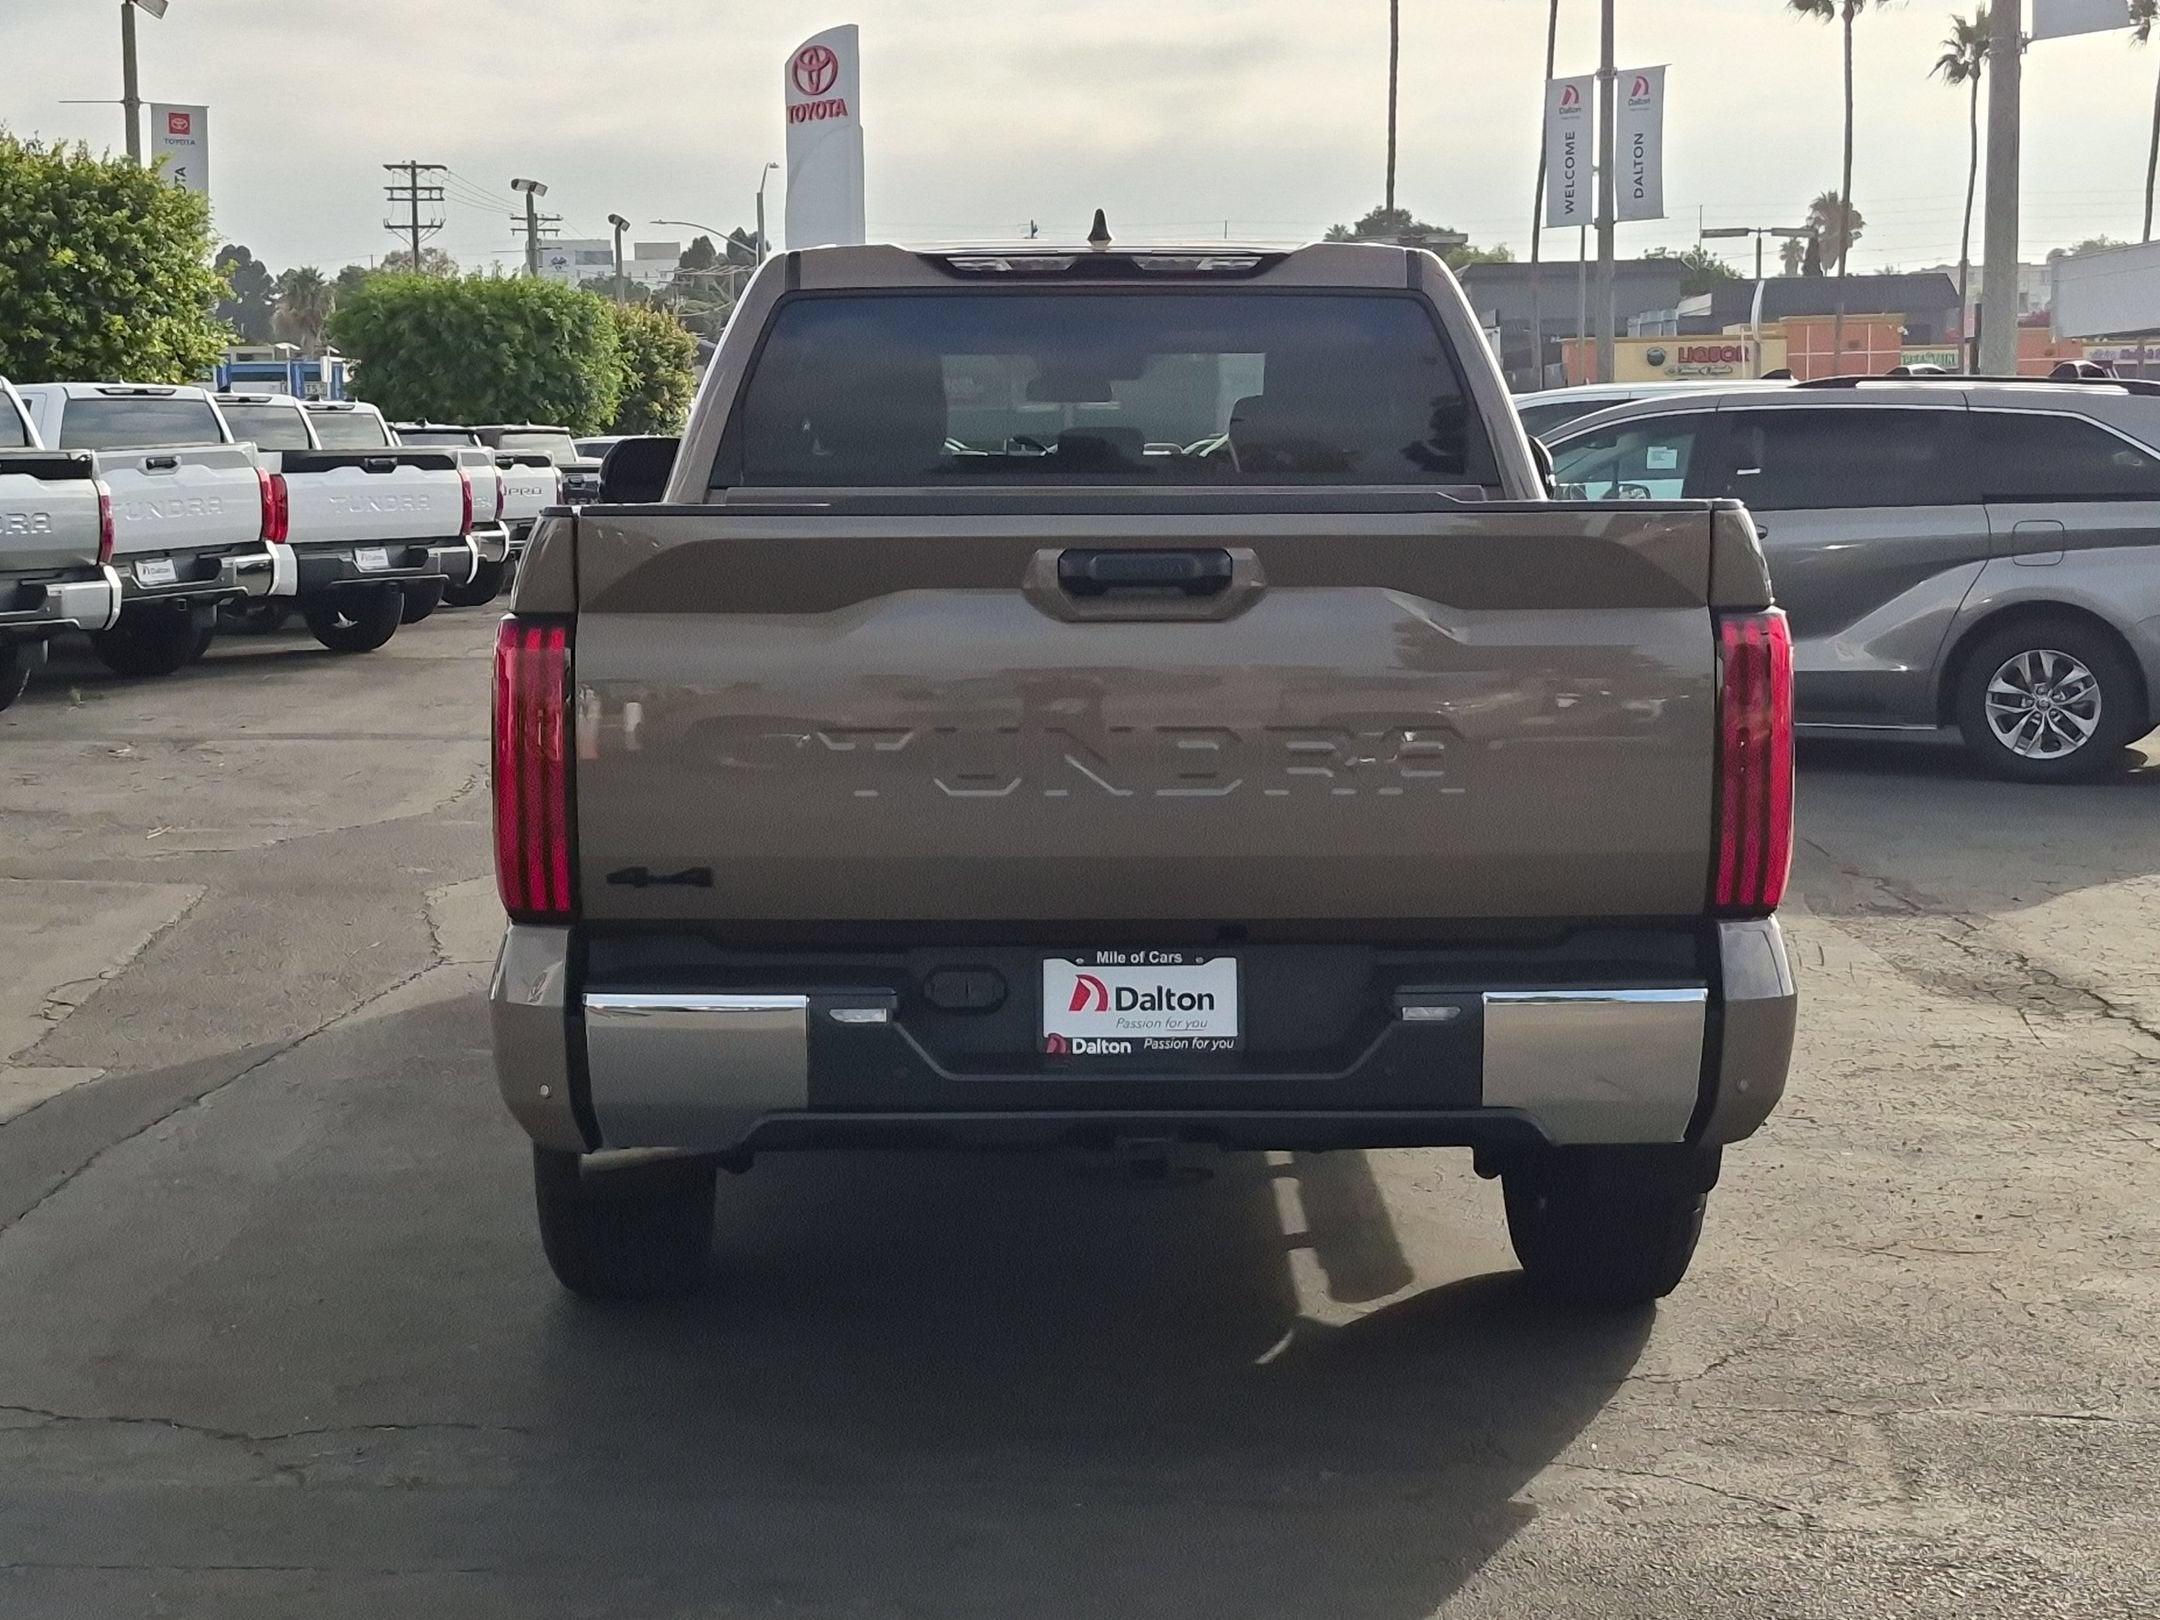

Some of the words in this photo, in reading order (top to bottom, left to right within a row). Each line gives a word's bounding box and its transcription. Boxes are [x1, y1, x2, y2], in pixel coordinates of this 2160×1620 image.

[787, 98, 848, 124] TOYOTA
[1559, 106, 1581, 114] Dalton
[1564, 131, 1576, 215] WELCOME
[1633, 132, 1644, 199] DALTON
[1678, 346, 1750, 363] LIQUOR
[329, 494, 431, 514] TUNDRA
[816, 725, 1467, 797] TUNDRA
[1097, 951, 1126, 964] Mile
[1130, 951, 1145, 964] of
[1149, 951, 1182, 964] Cars
[1115, 985, 1215, 1012] Dalton
[1116, 1018, 1161, 1029] Passion
[1166, 1016, 1183, 1029] for
[1185, 1020, 1208, 1031] you
[1072, 1038, 1132, 1055] Dalton
[1144, 1037, 1188, 1050] Passion
[1192, 1037, 1209, 1050] for
[1211, 1039, 1235, 1051] you
